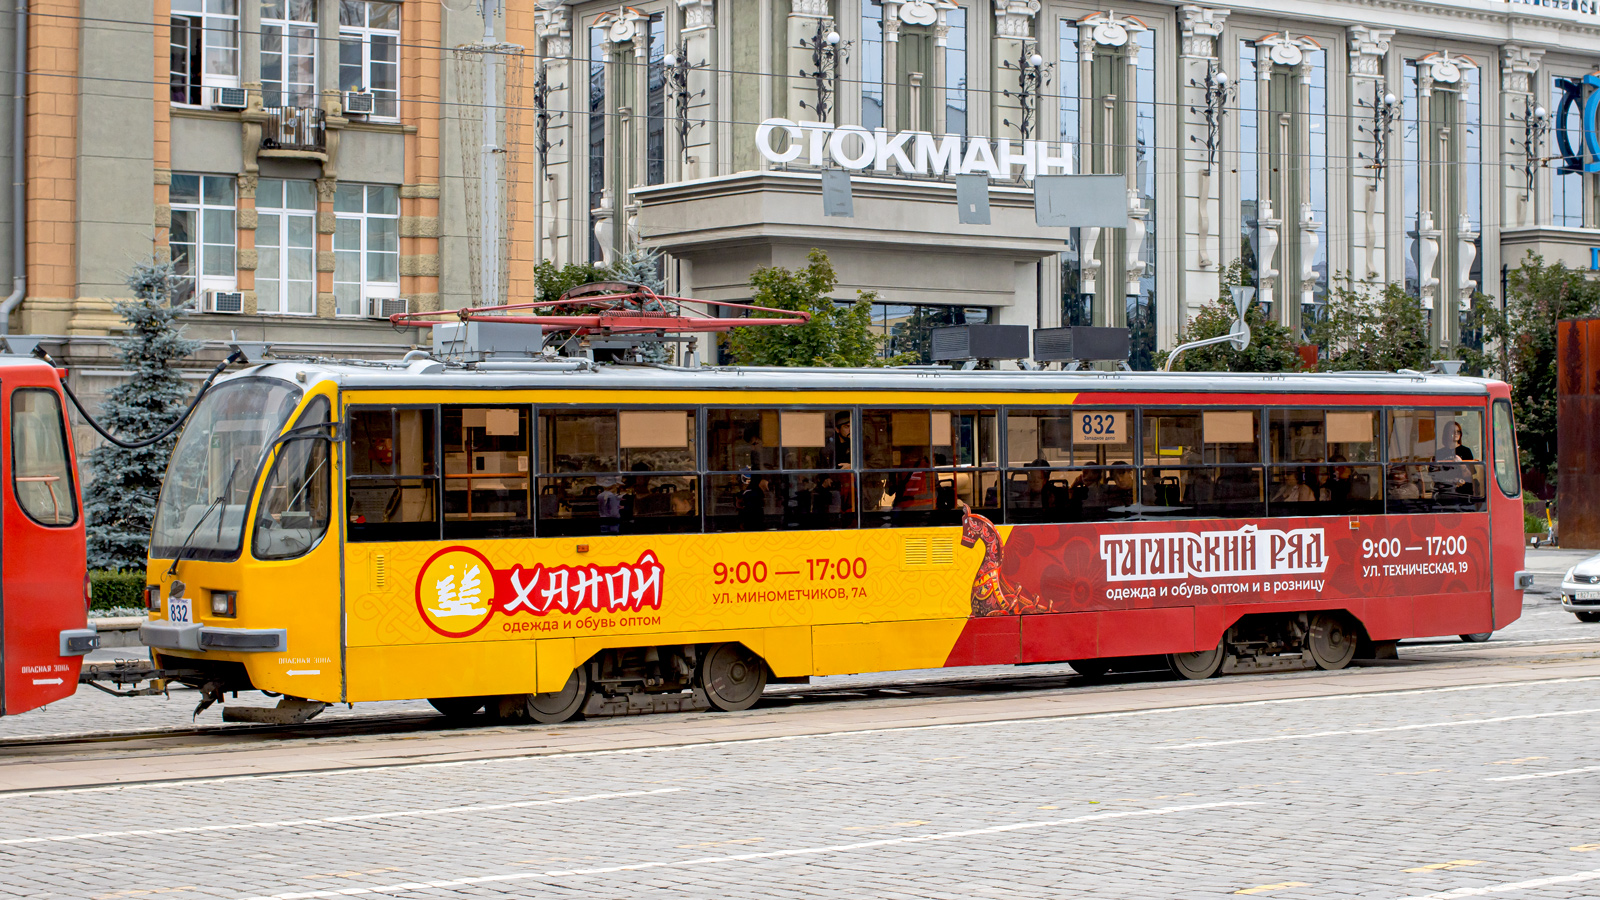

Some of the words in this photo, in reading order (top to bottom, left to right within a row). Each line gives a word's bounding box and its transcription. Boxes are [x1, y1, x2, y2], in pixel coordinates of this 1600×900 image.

[755, 118, 1073, 181] СТОКМАНН
[1082, 414, 1115, 435] 832
[1104, 529, 1257, 577] ТАГАНСКИЙ
[1270, 533, 1324, 570] РЯД
[1362, 537, 1401, 559] 9:00
[1426, 535, 1467, 556] 17:00
[713, 560, 768, 585] 9:00
[806, 557, 867, 581] 17:00
[1363, 565, 1381, 578] УЛ.
[1383, 562, 1457, 577] ТЕХНИЧЕСКАЯ,
[1458, 561, 1468, 573] 19
[503, 554, 661, 612] ХАНОЙ
[1106, 586, 1157, 600] одежда
[1159, 587, 1168, 596] и
[1171, 582, 1208, 599] обувь
[1211, 581, 1249, 594] оптом
[1252, 581, 1260, 592] и
[1263, 580, 1271, 591] в
[1273, 579, 1325, 594] розницу
[712, 592, 733, 604] УЛ.
[736, 587, 849, 603] МИНОМЕТЧИКОВ,
[170, 604, 188, 622] 832
[502, 620, 559, 633] одежда
[563, 620, 572, 629] и
[575, 616, 616, 631] обувь
[619, 616, 661, 626] оптом
[21, 665, 52, 674] ОПАСНАЯ
[53, 664, 69, 672] ЗОНА
[313, 656, 331, 664] ЗОНА
